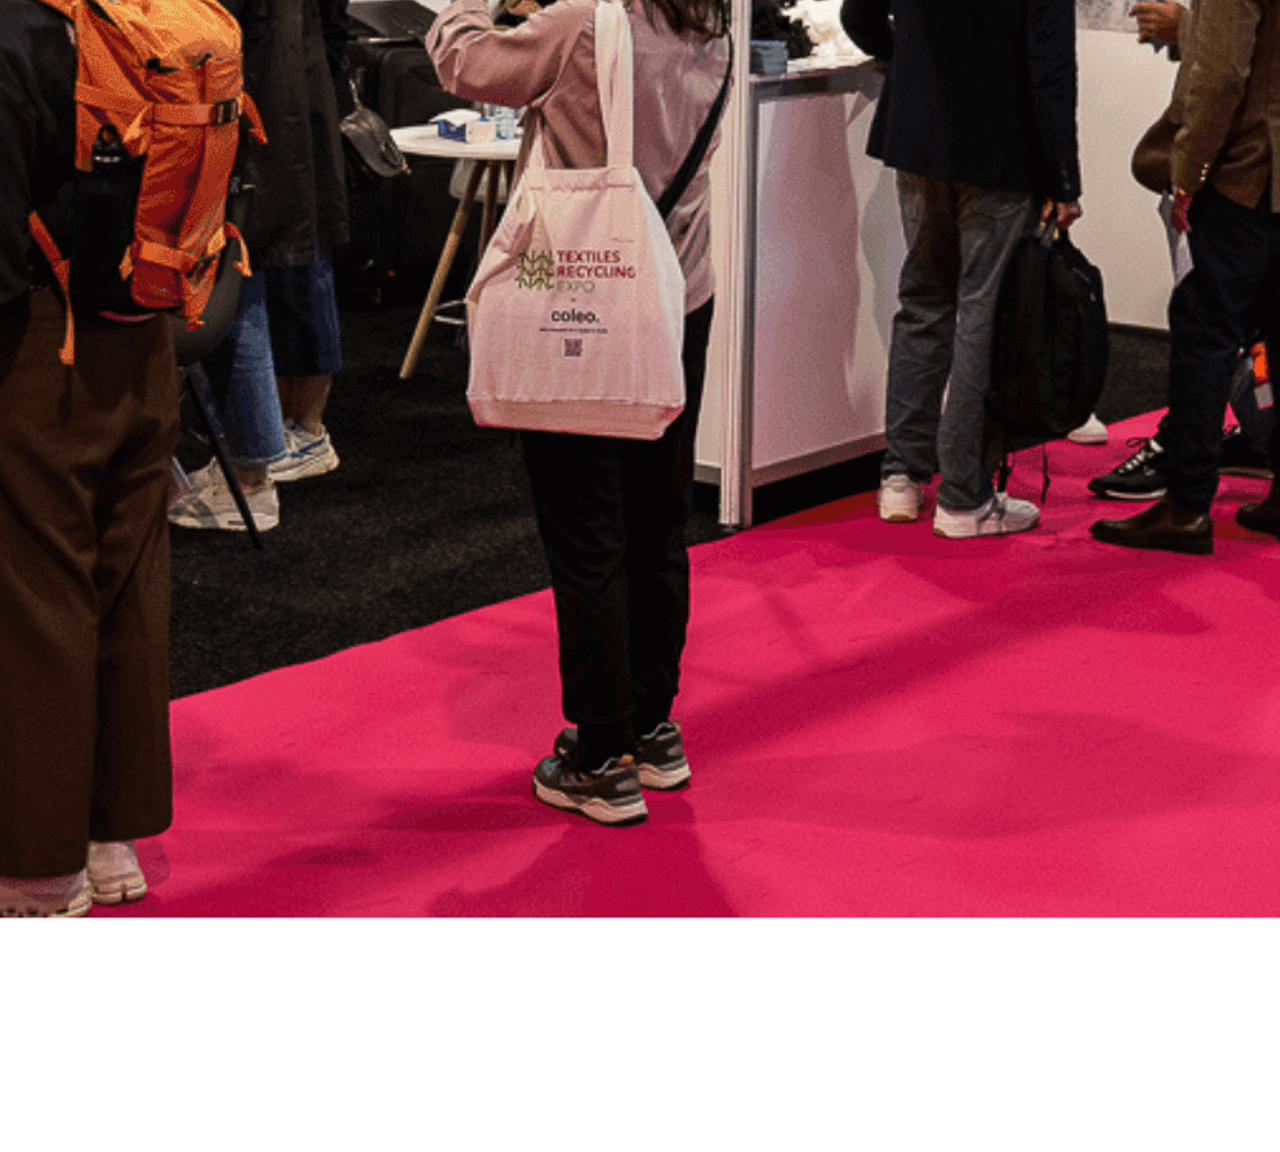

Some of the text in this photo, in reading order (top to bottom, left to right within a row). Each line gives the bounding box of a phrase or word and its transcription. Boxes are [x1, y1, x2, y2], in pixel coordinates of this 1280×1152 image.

[557, 250, 621, 263] TEXTILES
[556, 266, 636, 279] RECYCLING
[557, 280, 595, 293] EXPO
